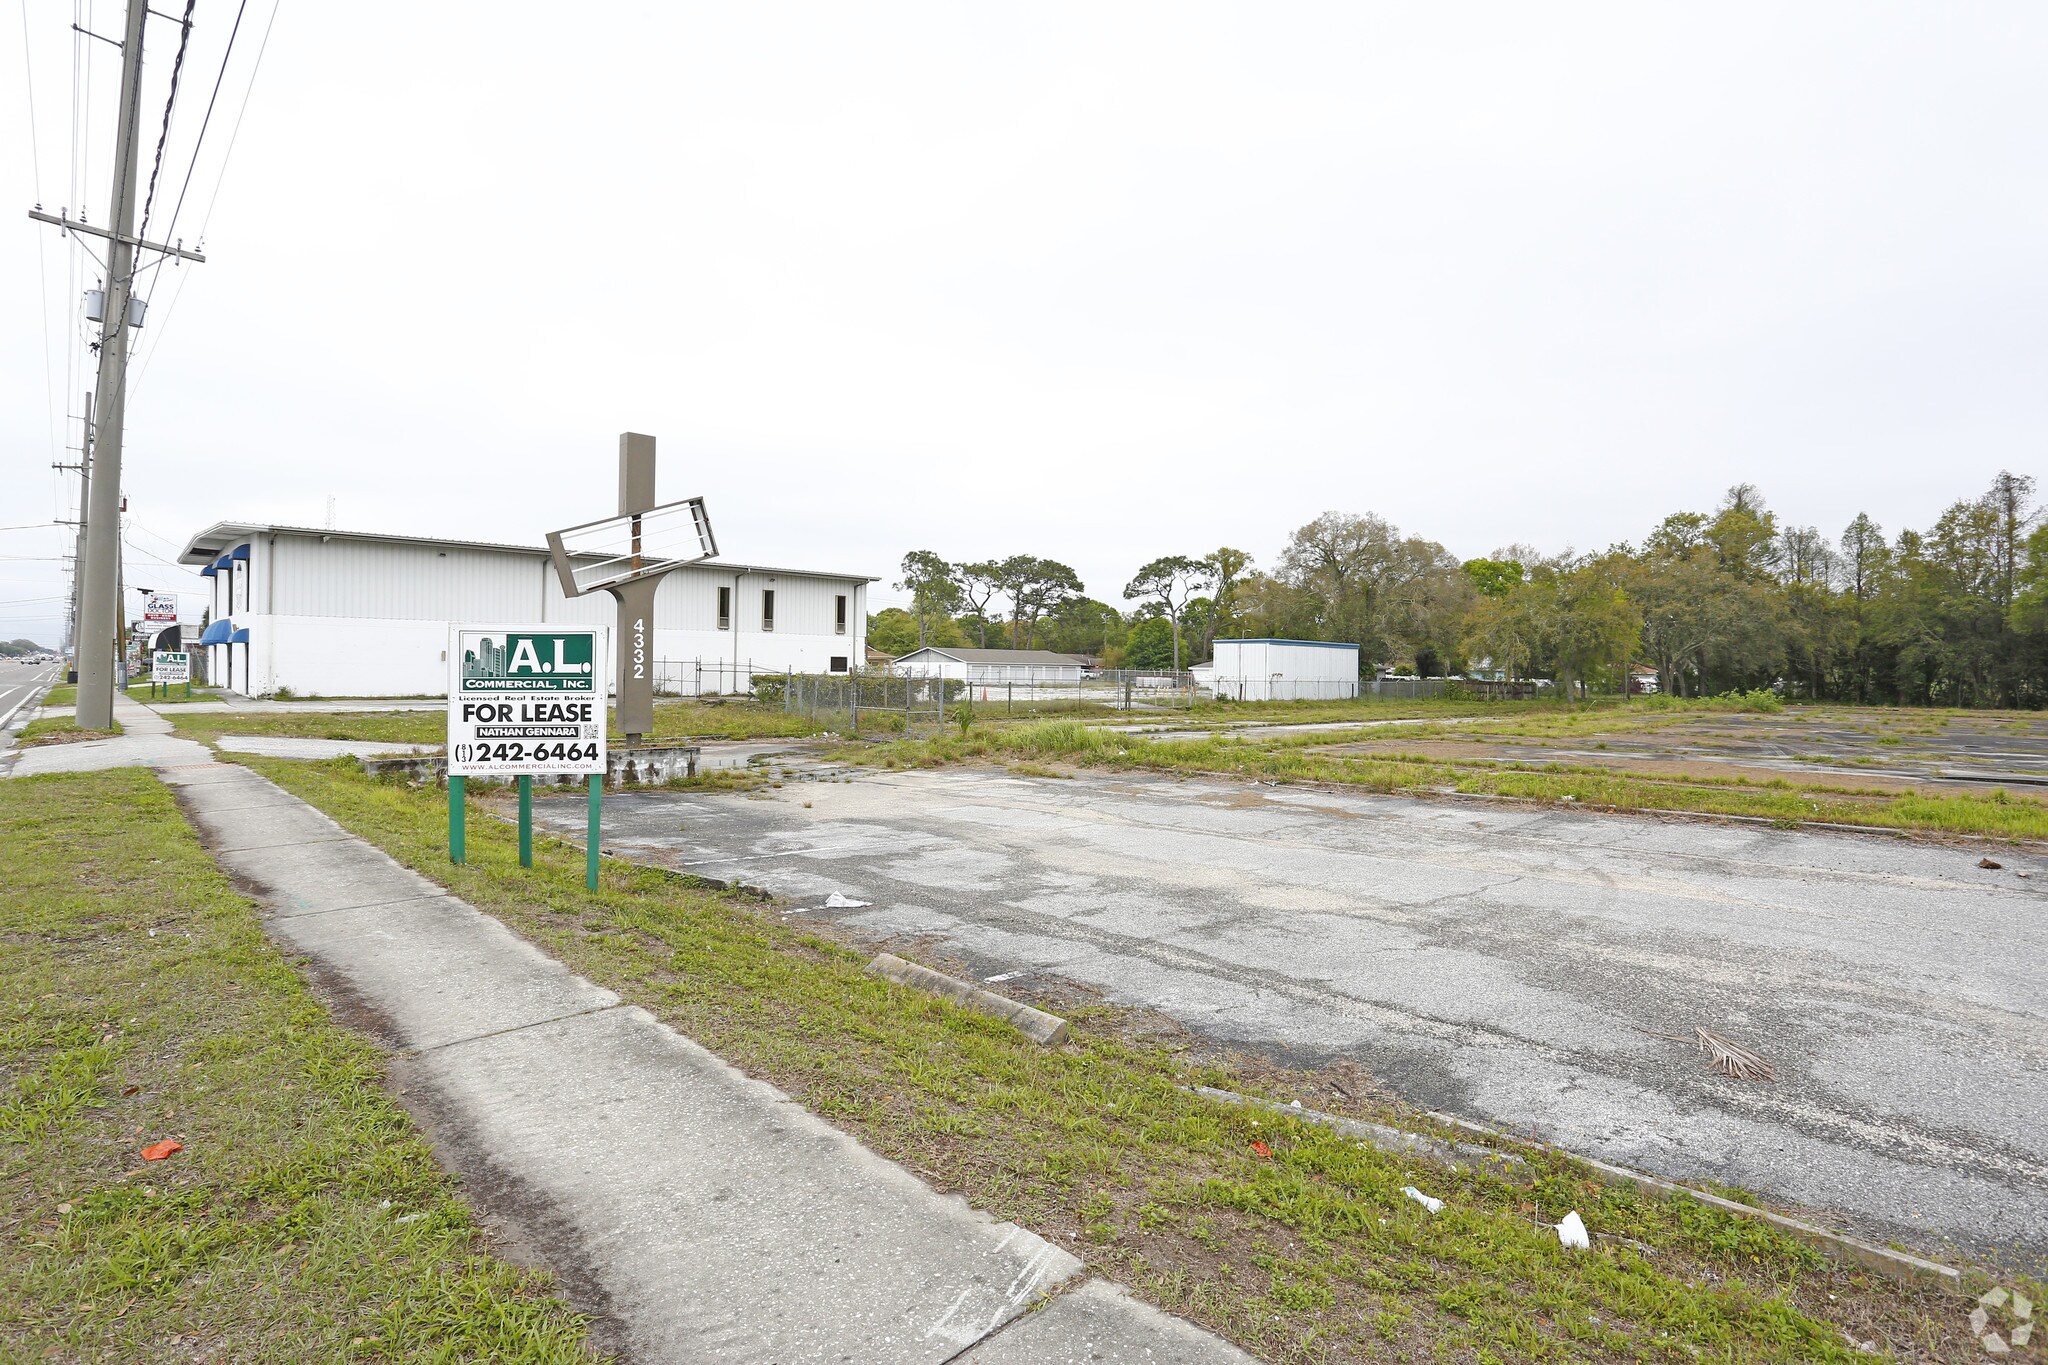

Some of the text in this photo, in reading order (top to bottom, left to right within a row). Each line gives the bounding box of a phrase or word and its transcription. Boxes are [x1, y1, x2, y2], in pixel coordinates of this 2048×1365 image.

[507, 638, 592, 674] A.L.
[633, 618, 645, 679] 4332
[465, 679, 589, 689] COMMERCIAL, INC.
[463, 703, 592, 722] FOR LEASE
[479, 727, 577, 737] NATHAN GENNARA
[476, 742, 599, 762] 242-6464
